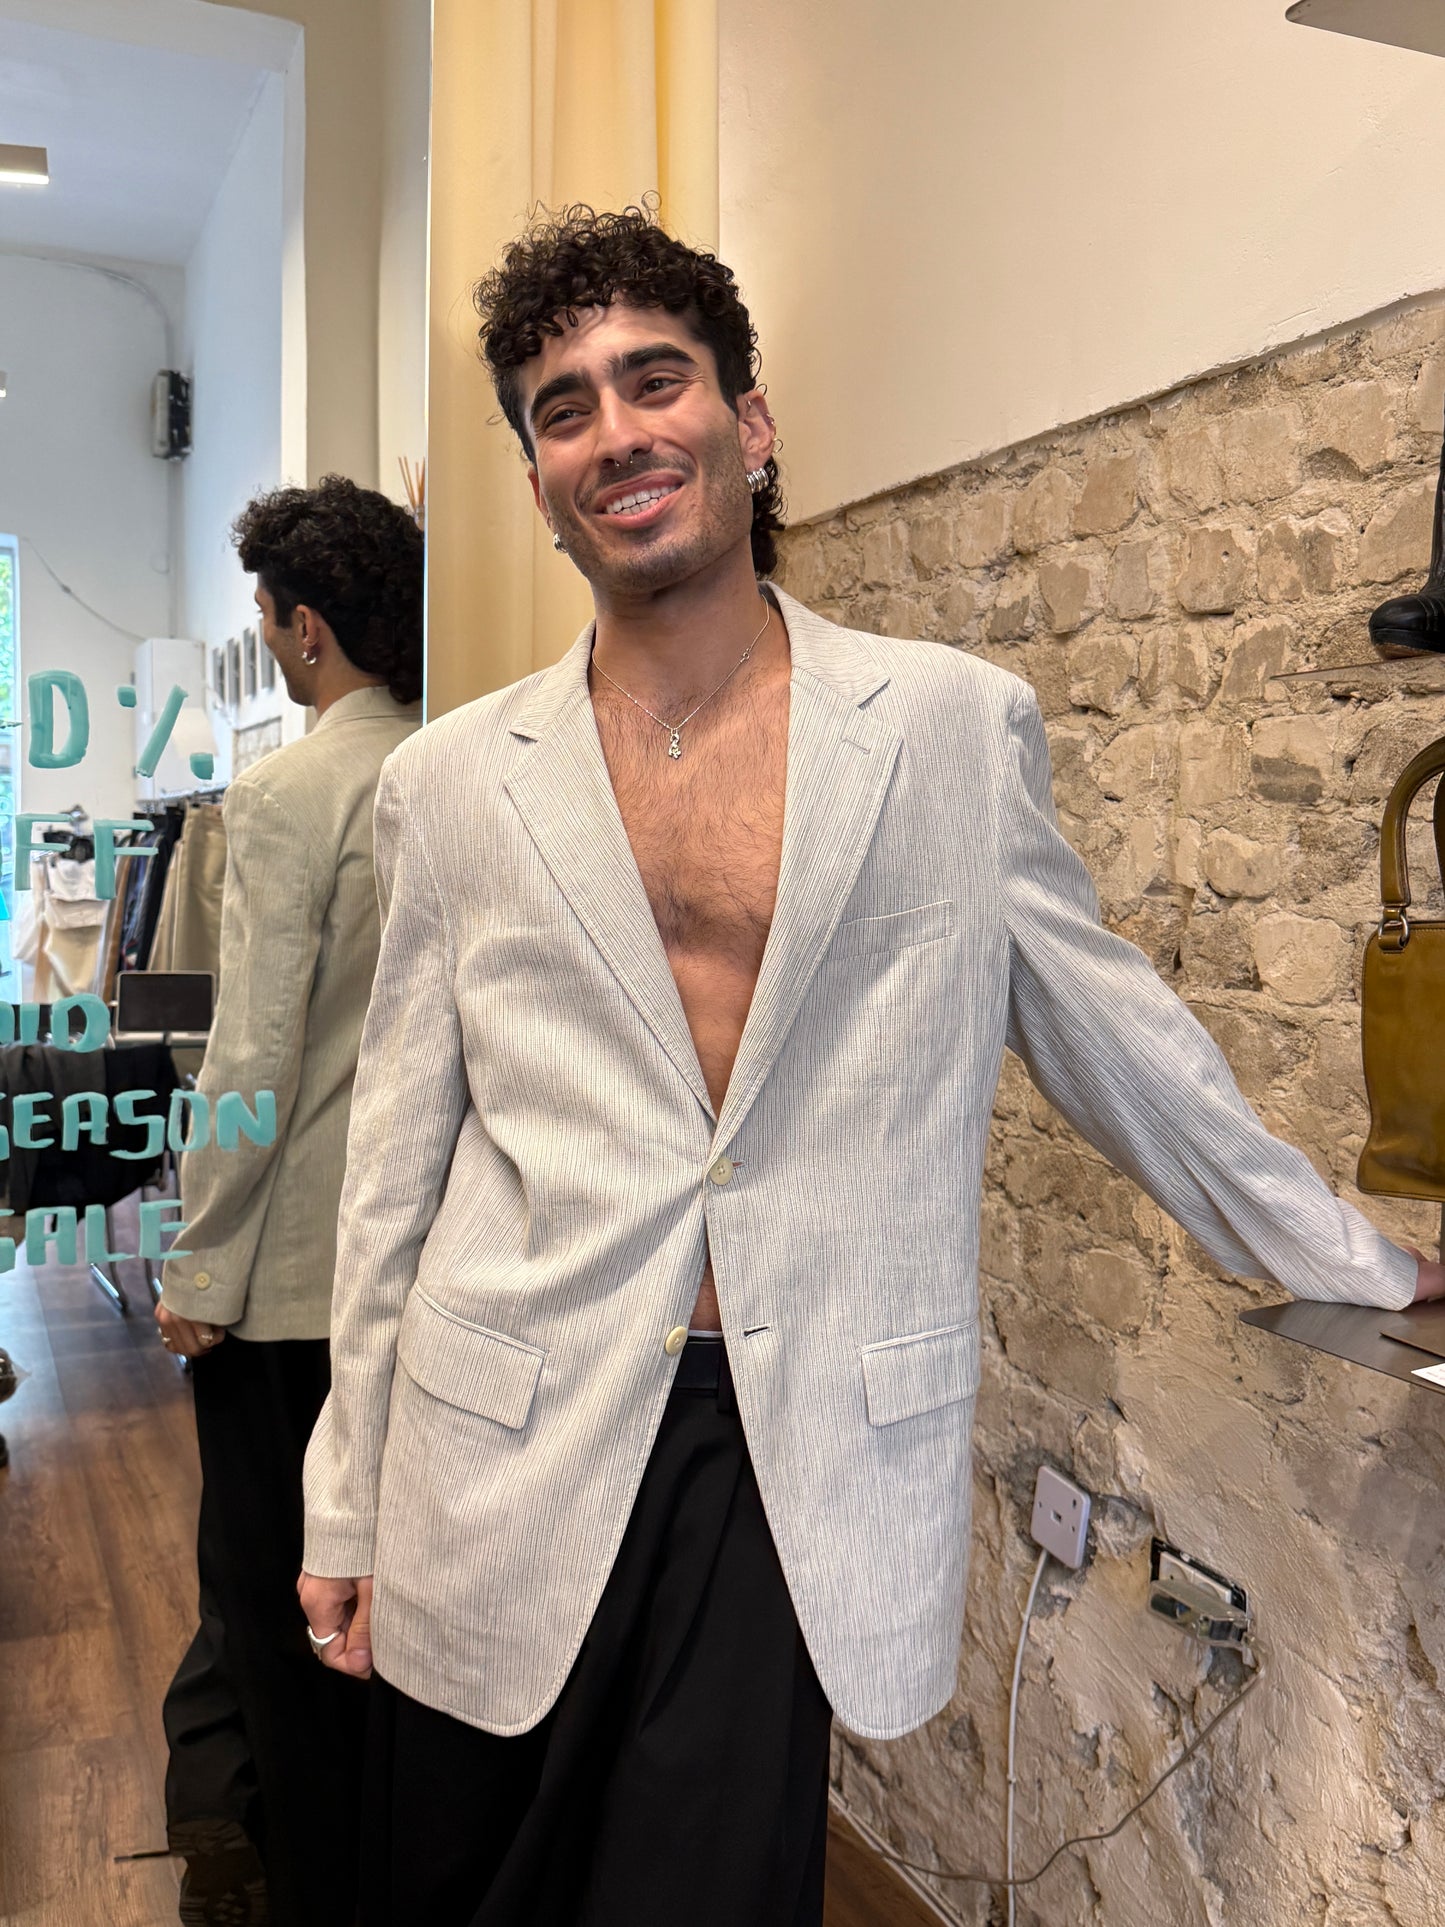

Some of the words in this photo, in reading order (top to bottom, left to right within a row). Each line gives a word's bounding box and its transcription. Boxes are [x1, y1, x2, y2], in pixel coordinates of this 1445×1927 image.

[0, 669, 214, 780] 0%
[0, 813, 158, 900] FF
[0, 1089, 277, 1161] EASON
